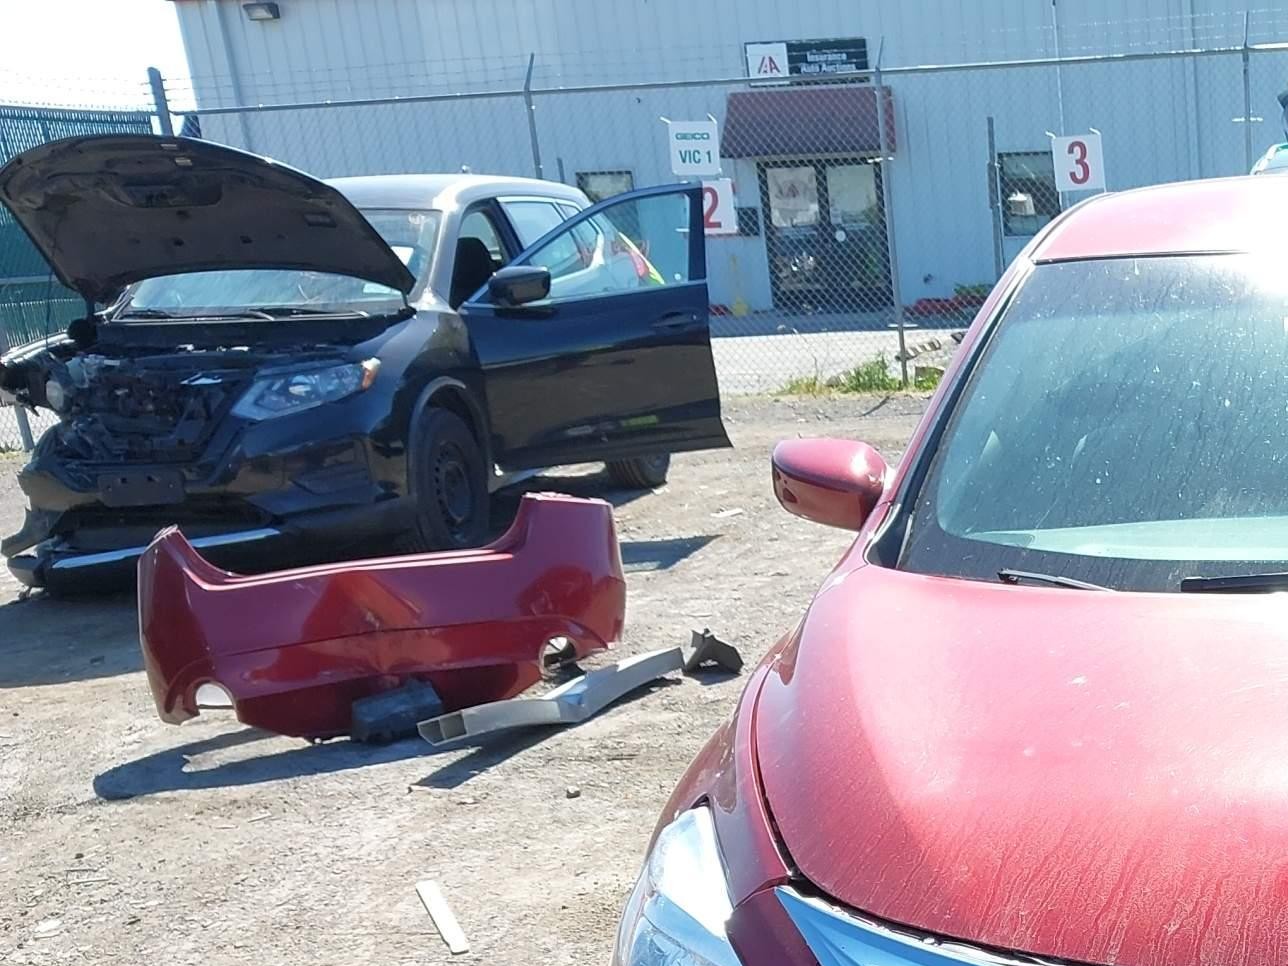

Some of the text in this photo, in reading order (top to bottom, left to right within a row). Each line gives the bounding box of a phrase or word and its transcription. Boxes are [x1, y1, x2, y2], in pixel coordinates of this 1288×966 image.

[675, 132, 710, 140] GEICO
[679, 150, 712, 164] VIC 1
[1067, 140, 1090, 185] 3
[703, 186, 722, 229] 2
